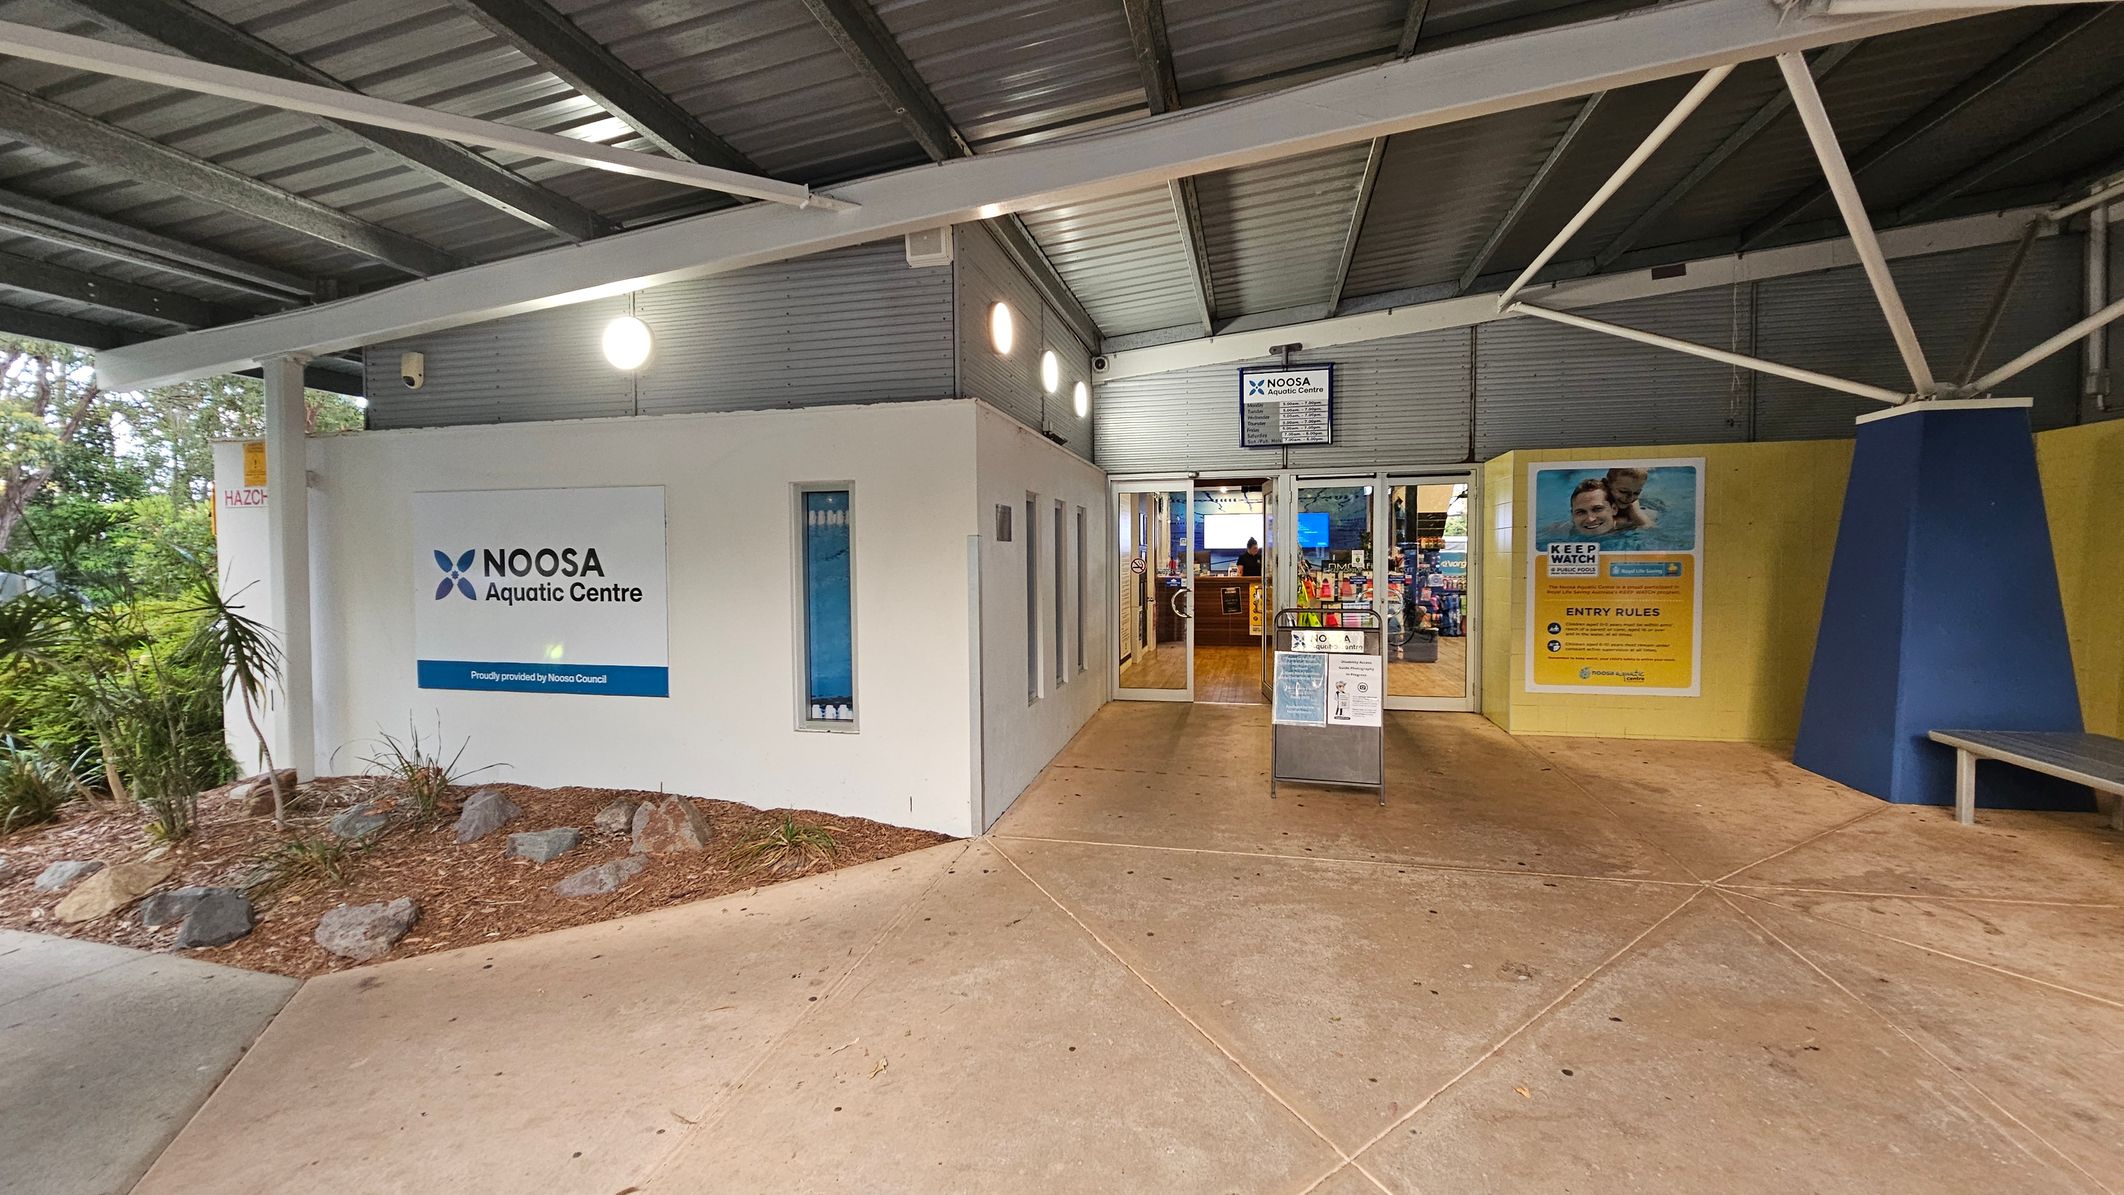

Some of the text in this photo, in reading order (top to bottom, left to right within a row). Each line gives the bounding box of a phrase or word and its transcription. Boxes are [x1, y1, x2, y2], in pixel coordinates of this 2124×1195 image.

[1268, 377, 1310, 388] NOOSA
[1551, 545, 1596, 554] KEEP
[484, 548, 605, 577] NOOSA
[1551, 555, 1595, 564] WATCH
[485, 582, 643, 606] Aquatic Centre
[1566, 608, 1660, 617] ENTRY RULES
[470, 670, 607, 684] Proudly provided by Noosa Council
